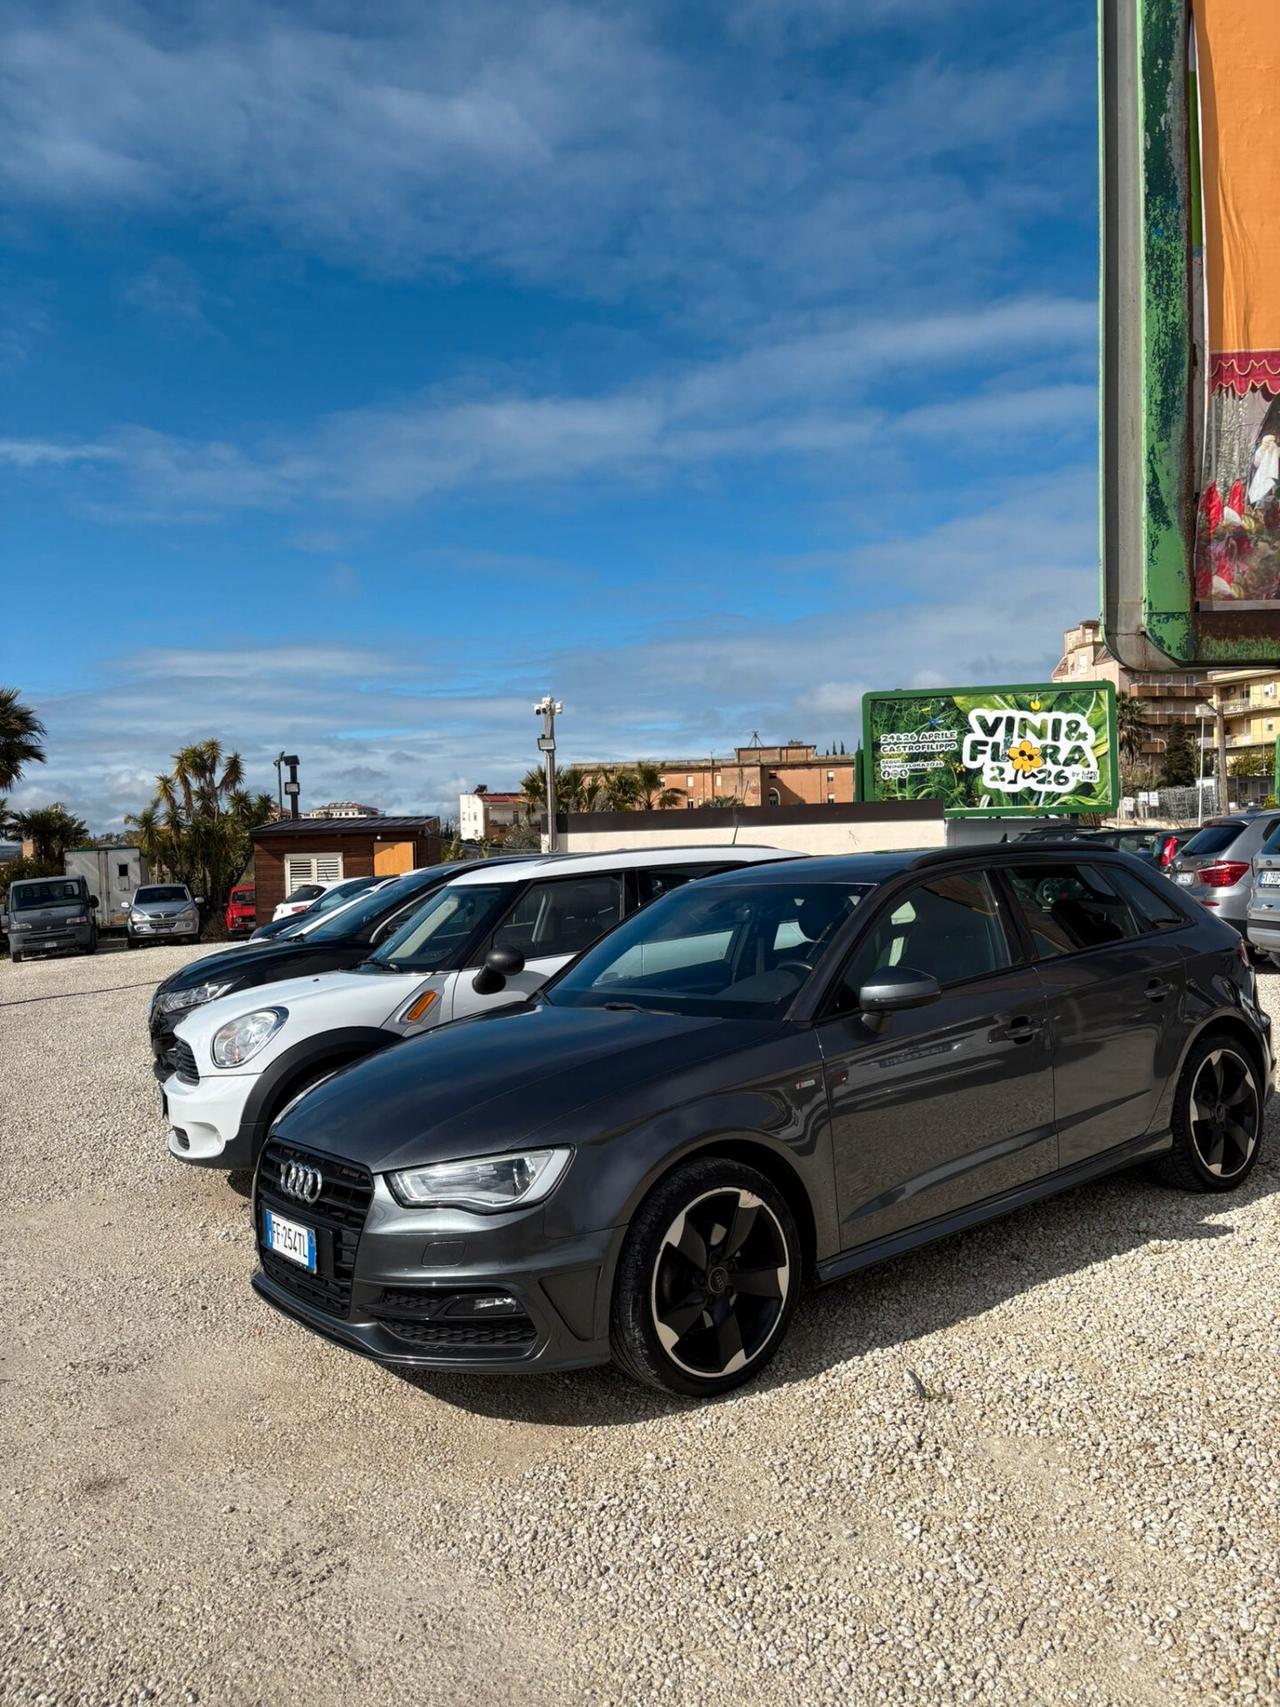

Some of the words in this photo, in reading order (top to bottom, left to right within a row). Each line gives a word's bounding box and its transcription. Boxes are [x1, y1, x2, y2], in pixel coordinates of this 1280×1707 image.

[920, 731, 956, 741] APRILE
[975, 715, 1088, 741] VINI&
[881, 743, 956, 753] CASTROFILIPPO
[969, 740, 1090, 768] FLRA
[989, 766, 1070, 786] 226
